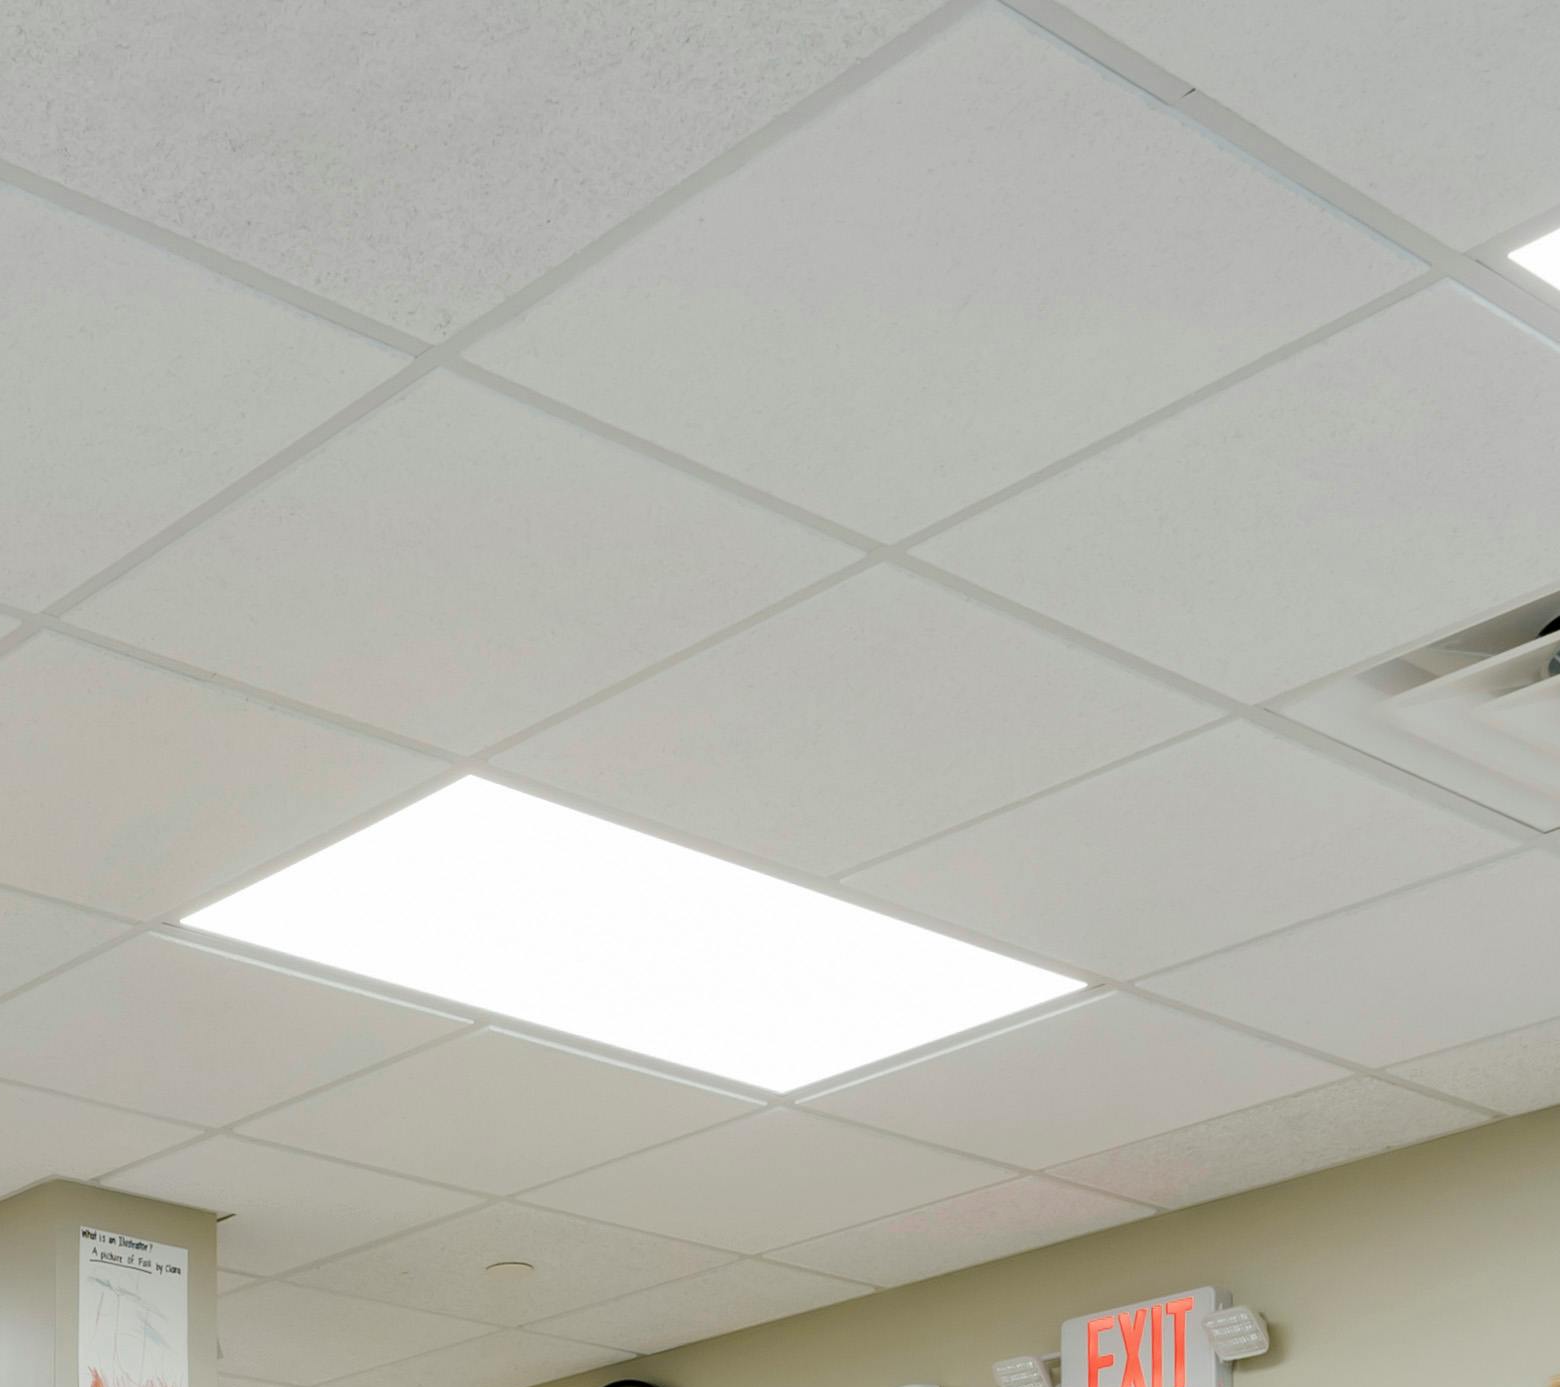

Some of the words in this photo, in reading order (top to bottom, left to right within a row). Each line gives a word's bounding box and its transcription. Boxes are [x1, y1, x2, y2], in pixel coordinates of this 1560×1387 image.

[91, 1246, 98, 1256] A
[100, 1251, 123, 1263] picture
[127, 1254, 135, 1265] of
[138, 1257, 152, 1268] Fall
[155, 1263, 163, 1275] by
[165, 1264, 182, 1275] Clara
